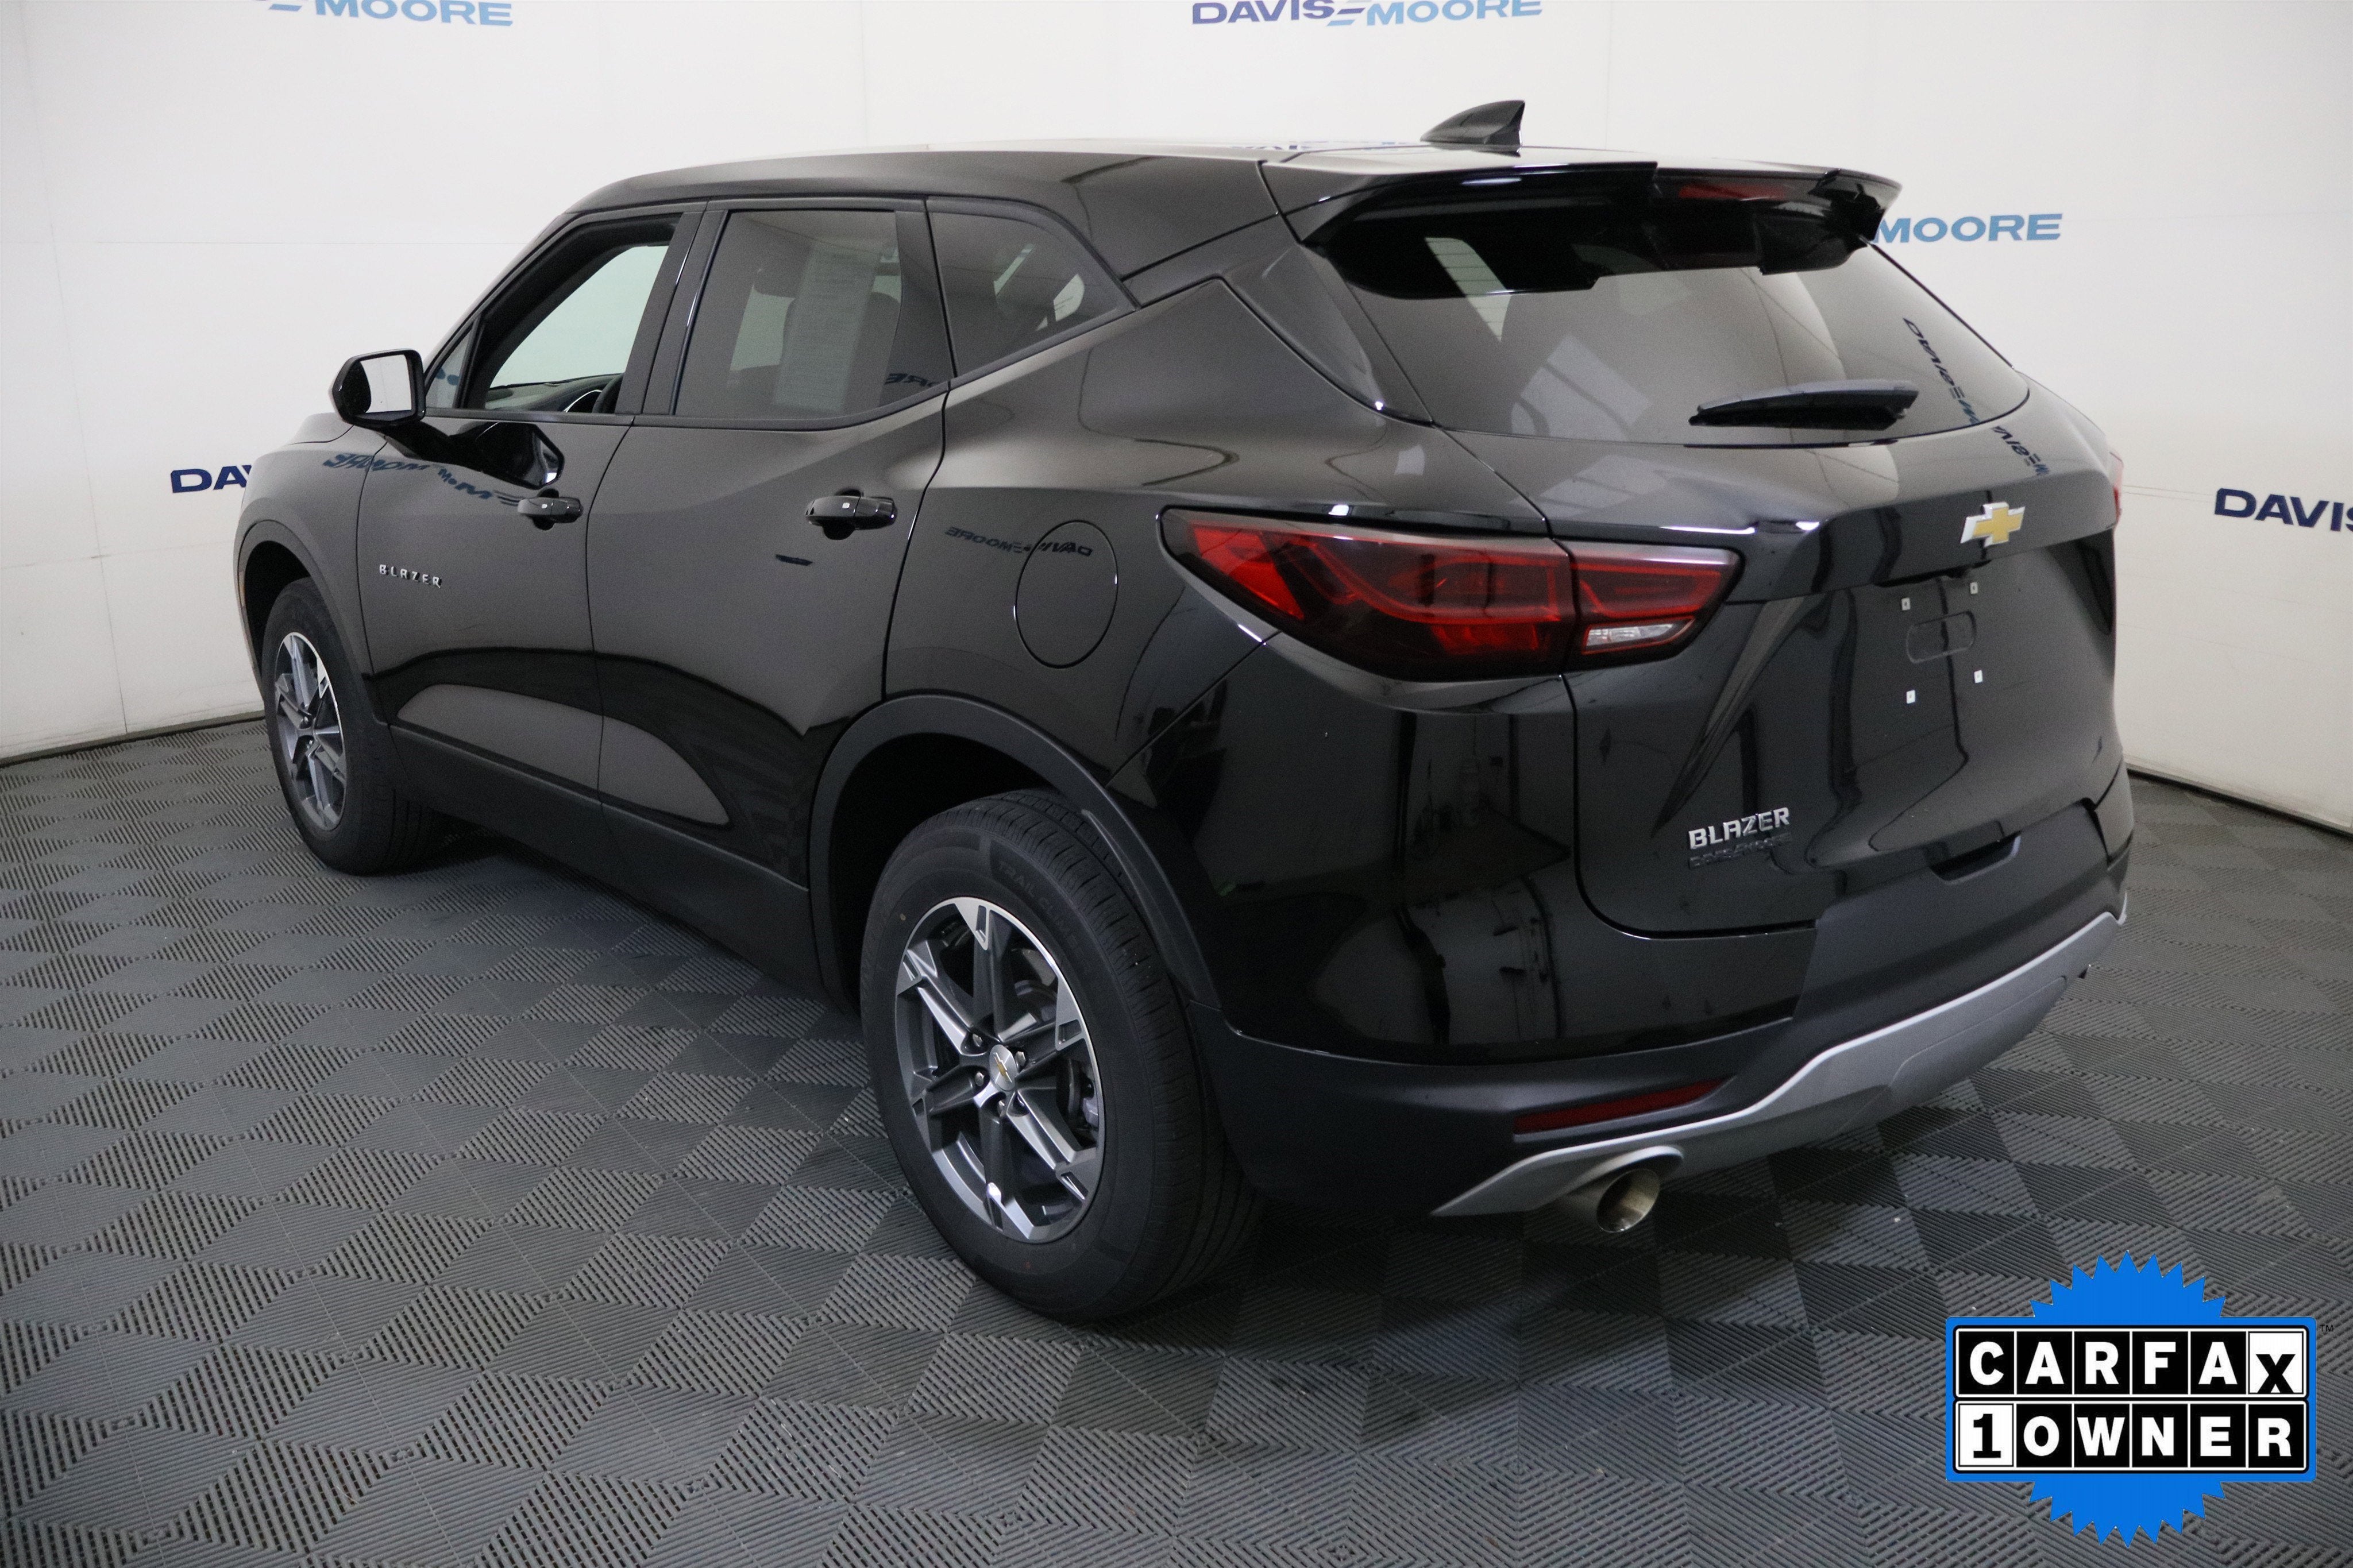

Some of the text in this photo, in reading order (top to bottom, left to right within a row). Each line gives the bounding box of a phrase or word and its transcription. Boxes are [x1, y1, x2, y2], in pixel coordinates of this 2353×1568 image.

[315, 0, 513, 26] MOORE
[1192, 0, 1543, 26] DAVIS MOORE
[1873, 213, 2063, 244] MOORE
[171, 465, 252, 493] DA
[2214, 488, 2353, 533] DAVI
[379, 564, 441, 589] BLAZER
[1688, 807, 1790, 850] BLAZER
